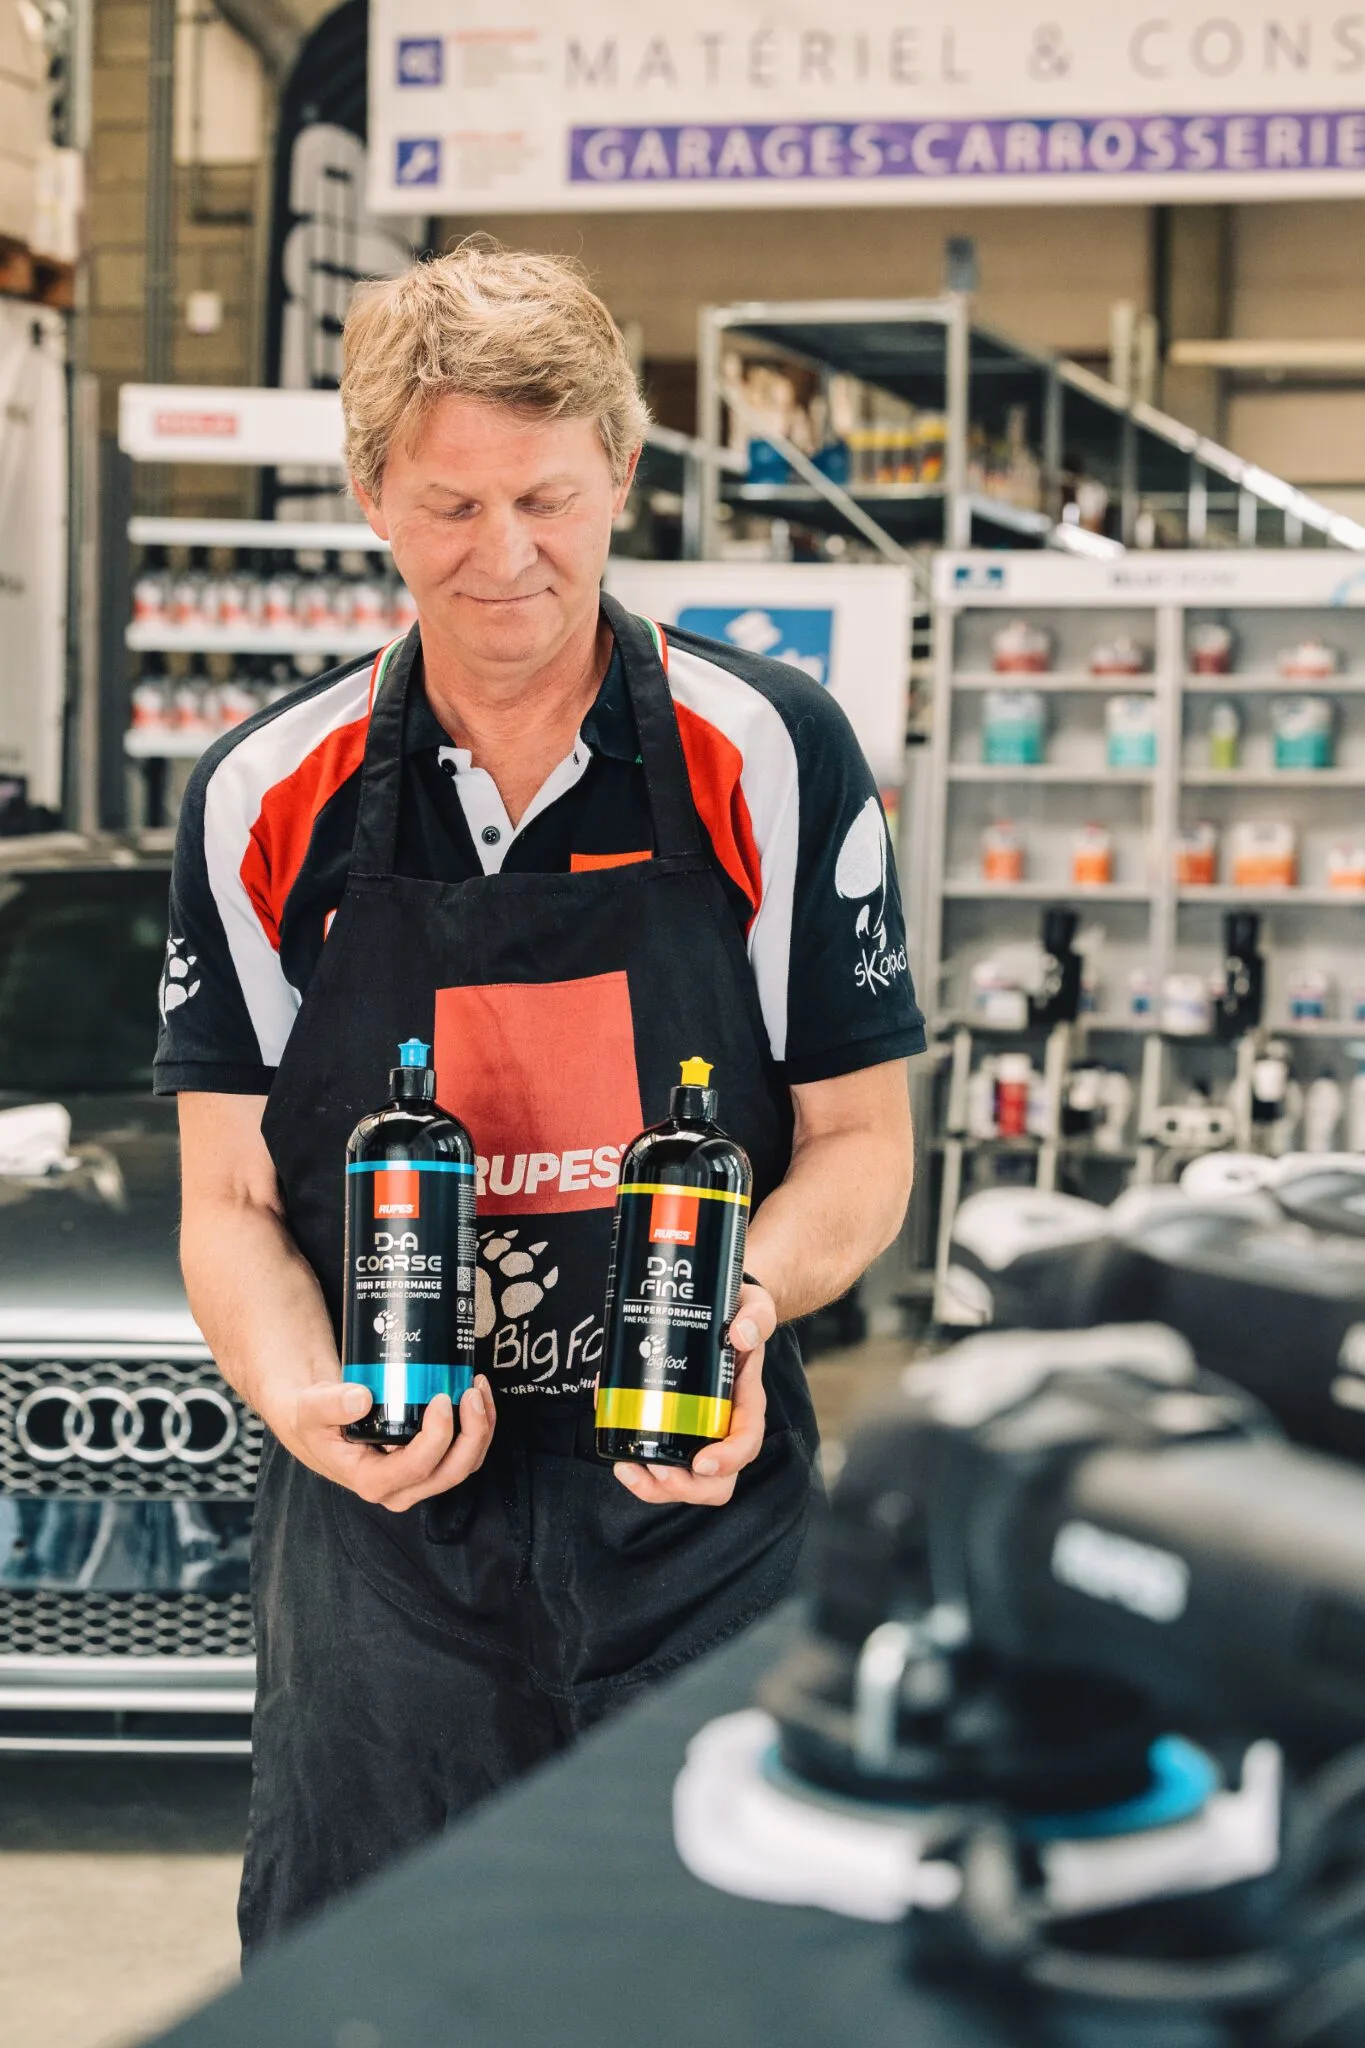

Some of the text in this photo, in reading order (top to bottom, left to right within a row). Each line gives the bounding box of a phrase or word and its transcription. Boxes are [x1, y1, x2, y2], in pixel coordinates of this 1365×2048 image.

[1026, 20, 1073, 83] &
[1127, 13, 1365, 81] CONS
[378, 1204, 415, 1214] RUPES
[653, 1228, 691, 1241] RUPES
[355, 1255, 442, 1272] COARSE
[356, 1280, 442, 1290] HIGH PERFORMANCE
[640, 1279, 694, 1299] FINE
[404, 1291, 441, 1299] COMPOUND
[623, 1304, 712, 1321] HIGH PERFORMANCE
[624, 1315, 637, 1323] FINE
[672, 1319, 709, 1330] COMPOUND
